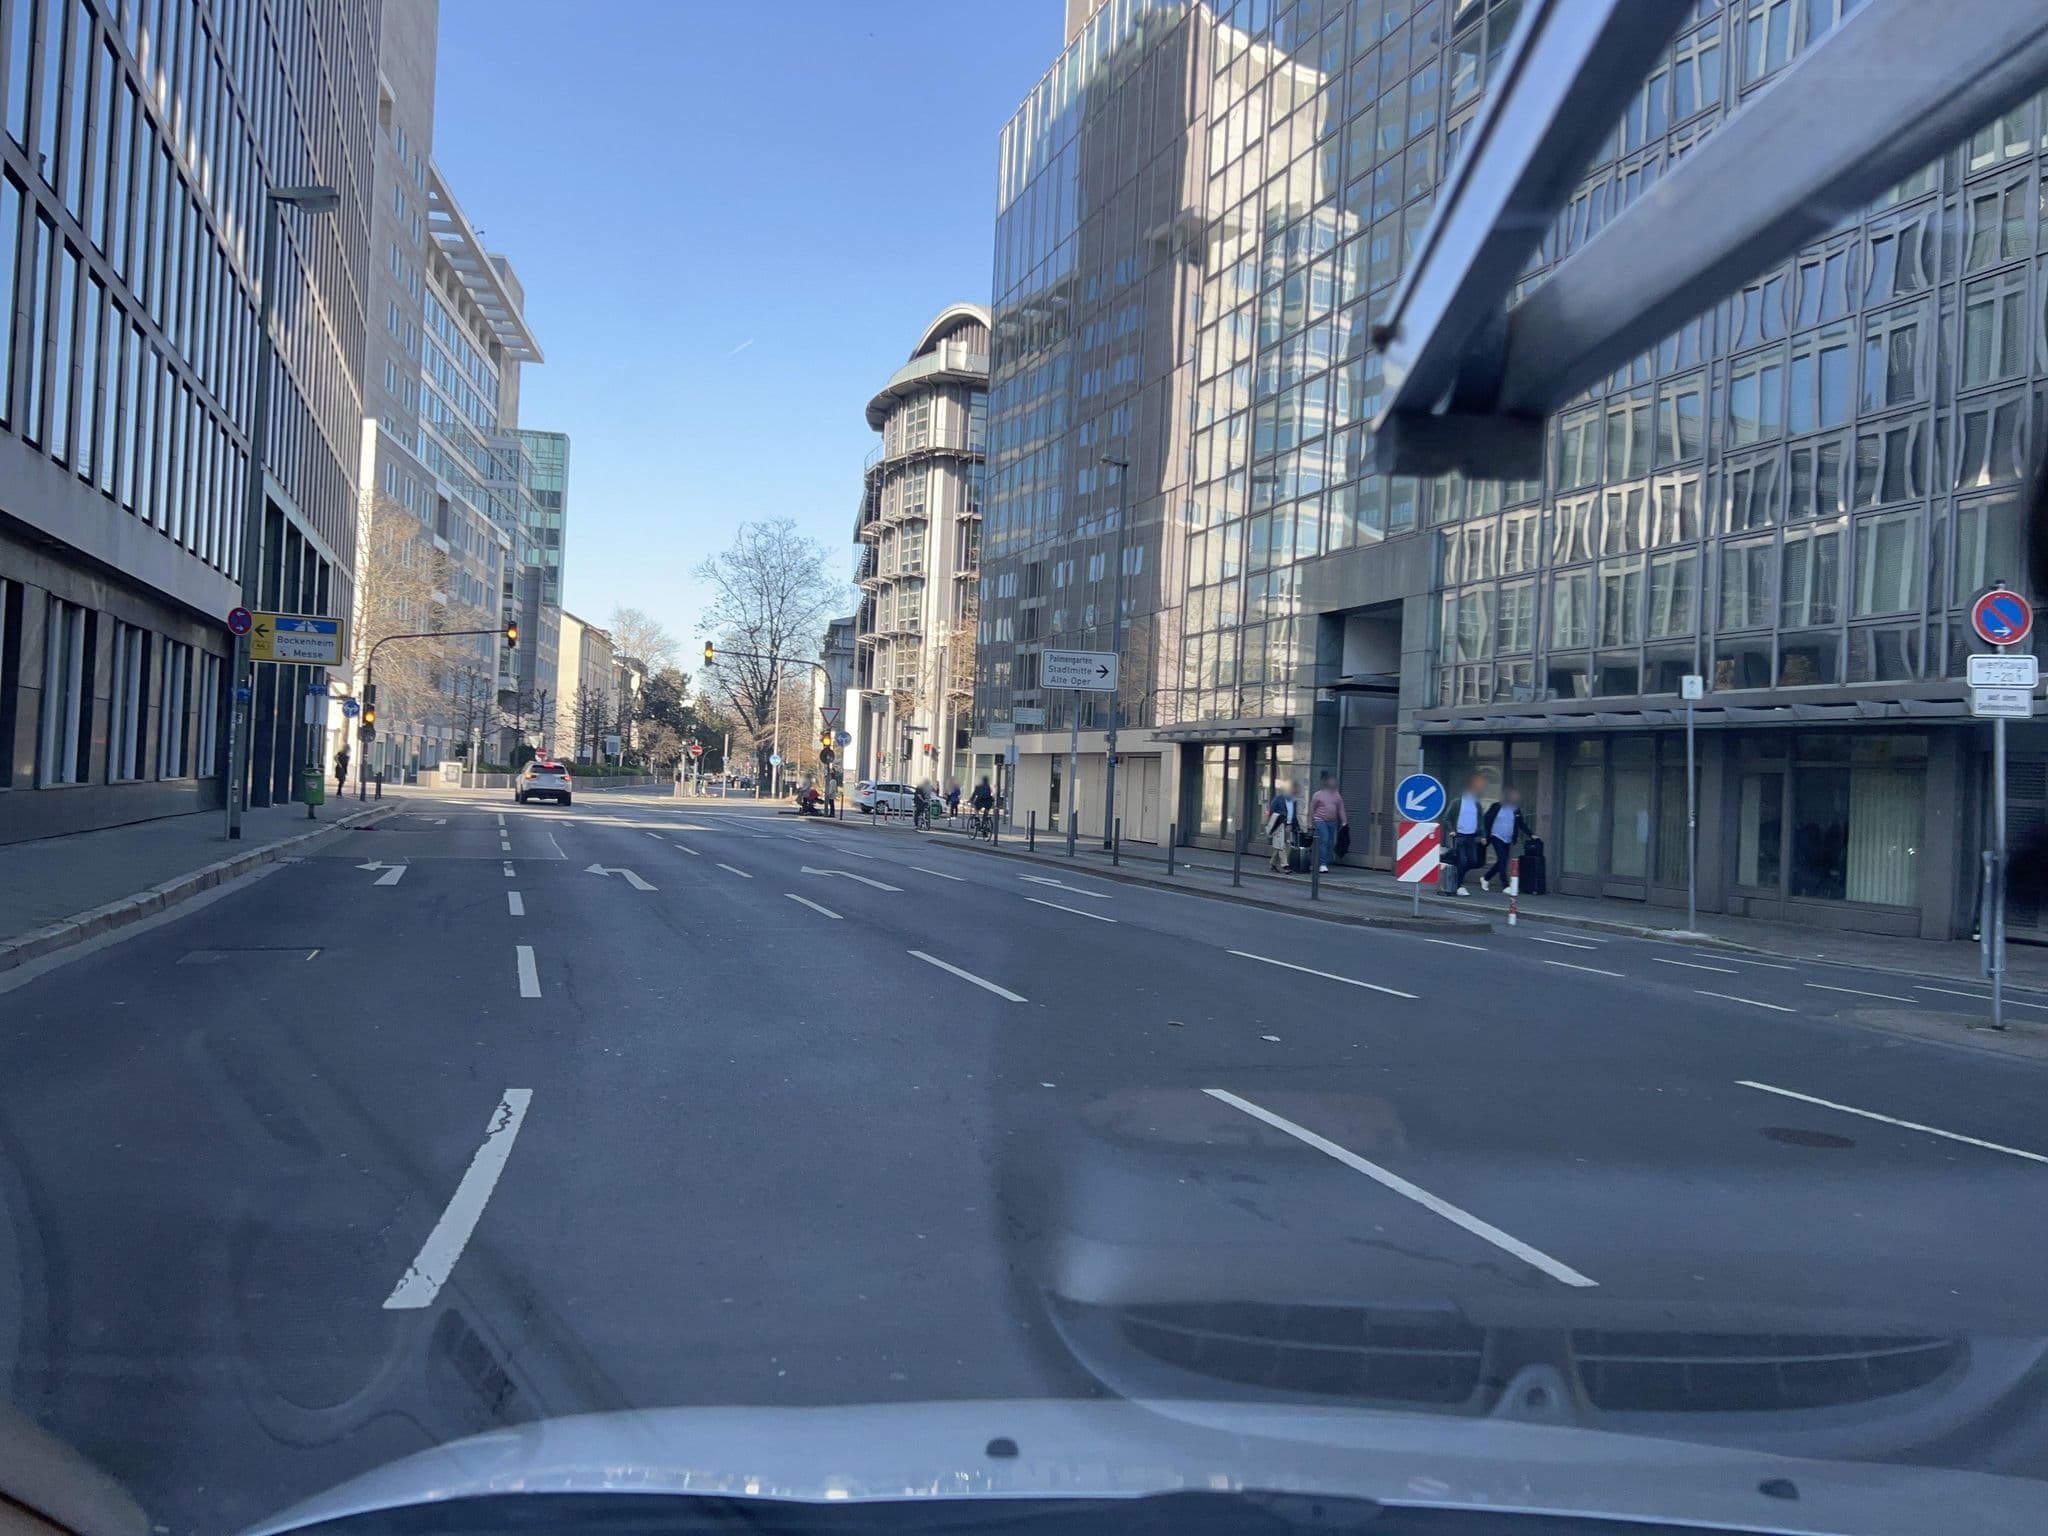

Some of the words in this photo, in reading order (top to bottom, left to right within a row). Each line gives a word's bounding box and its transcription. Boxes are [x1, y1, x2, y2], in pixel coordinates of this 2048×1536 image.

[277, 636, 334, 647] Bockenheim
[293, 649, 323, 658] Messe
[1049, 654, 1093, 665] Palmengarten
[1048, 665, 1092, 675] Stadtmitte
[1050, 676, 1067, 684] Alte
[1071, 677, 1091, 686] Oper
